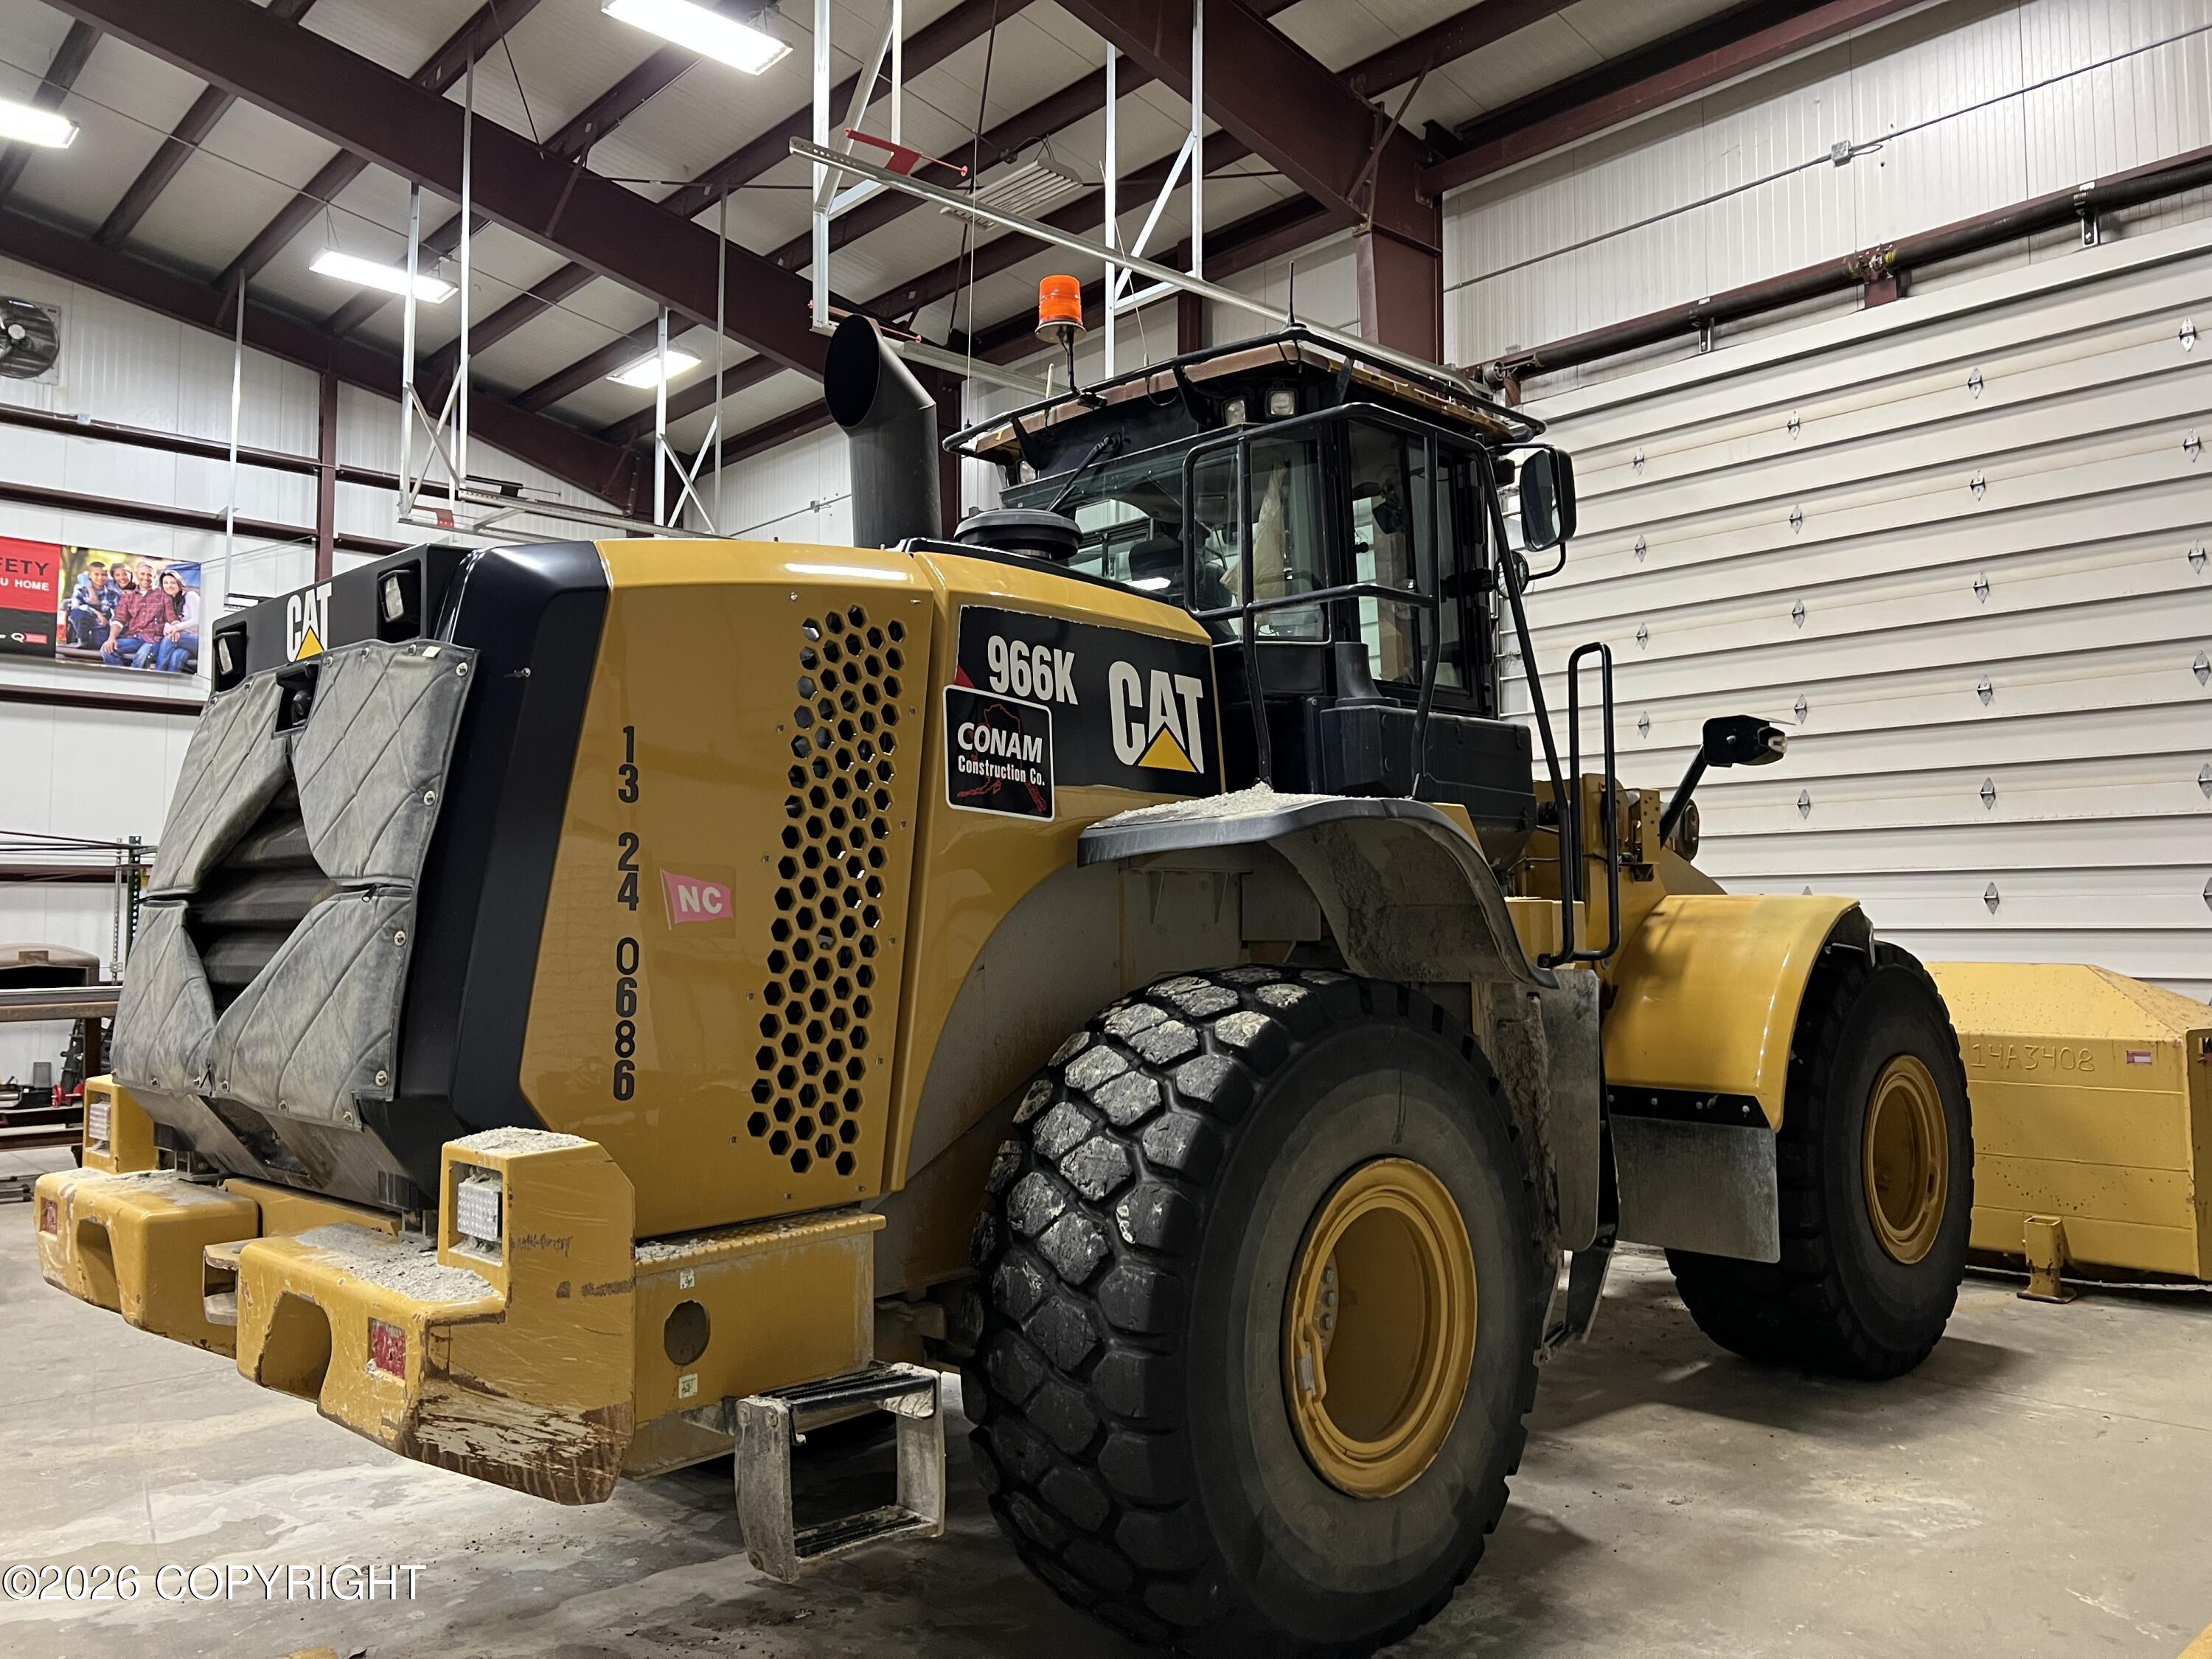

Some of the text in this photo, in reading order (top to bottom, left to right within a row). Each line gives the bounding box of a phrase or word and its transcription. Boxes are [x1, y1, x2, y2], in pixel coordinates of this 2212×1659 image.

[0, 557, 49, 576] ETY
[15, 578, 50, 591] HOME
[287, 582, 332, 662] CAT
[987, 635, 1079, 705] 966K
[1108, 661, 1204, 773] CAT
[958, 723, 1043, 763] CONAM
[958, 755, 1046, 786] Construction Co.
[613, 726, 639, 1101] 13 24 0686
[678, 885, 722, 914] NC
[1970, 1043, 2094, 1071] 14A3408
